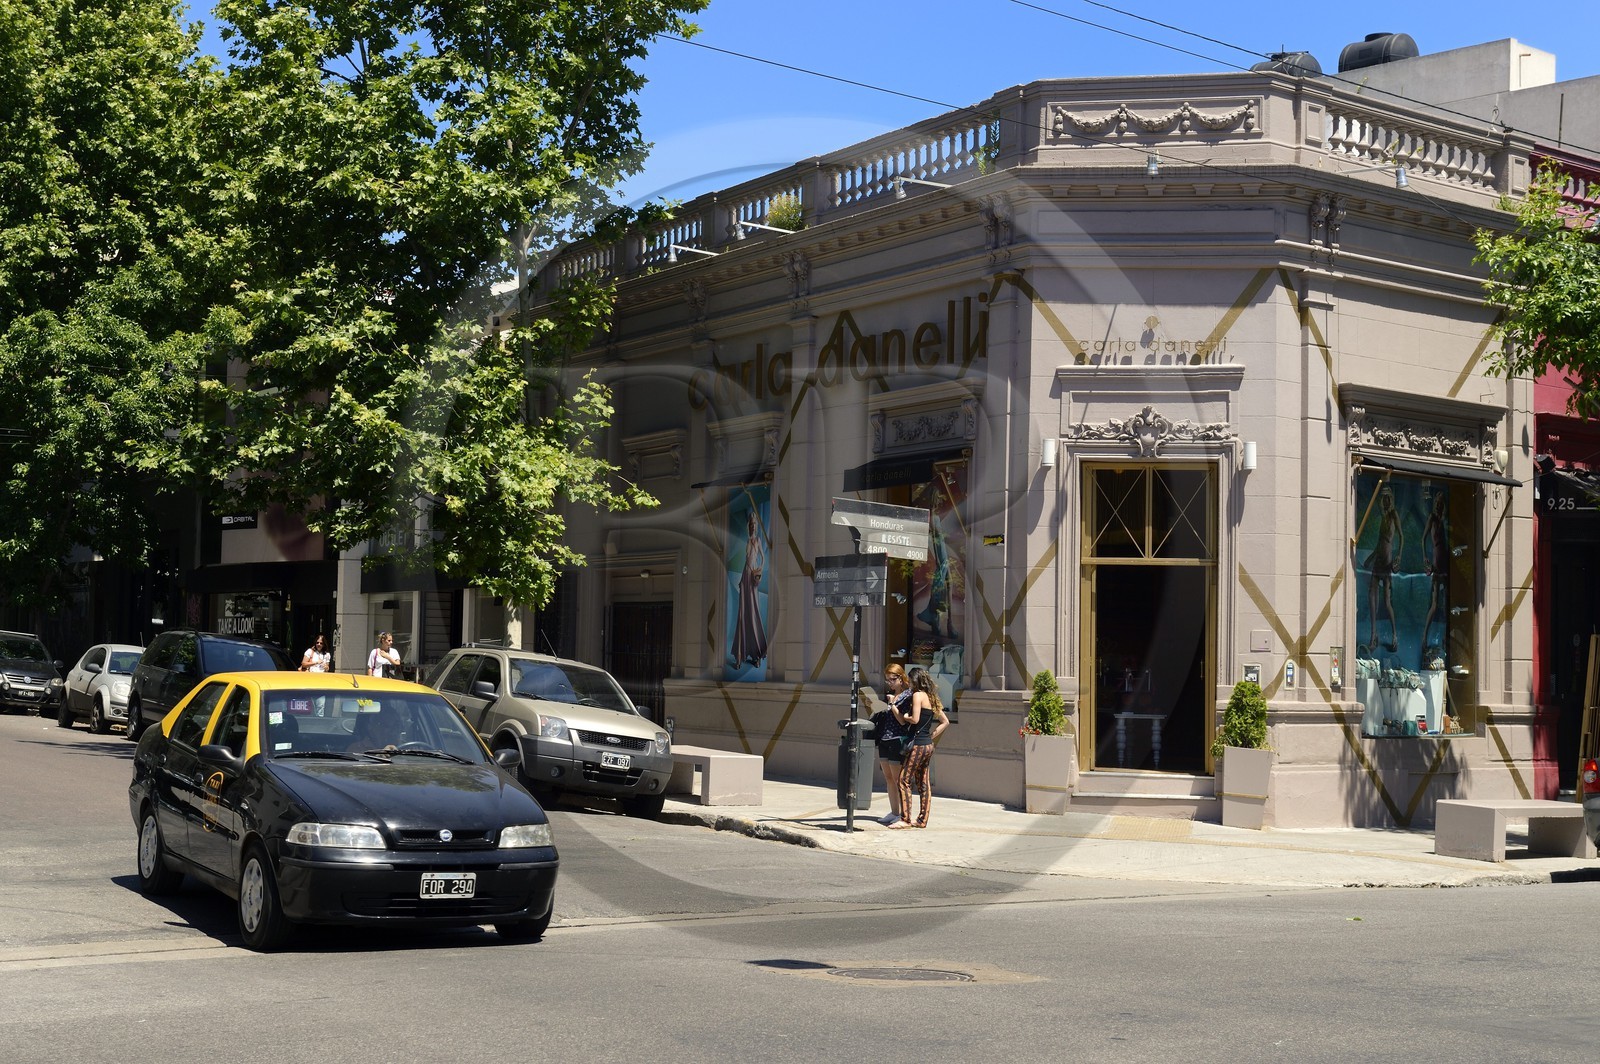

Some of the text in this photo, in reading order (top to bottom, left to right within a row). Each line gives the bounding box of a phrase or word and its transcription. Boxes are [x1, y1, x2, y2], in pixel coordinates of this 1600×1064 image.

[1078, 337, 1228, 353] carla danelli
[687, 292, 988, 411] carla danelli
[1547, 497, 1575, 510] 9.25
[870, 518, 904, 531] Honduras
[906, 550, 924, 560] 4900
[816, 570, 839, 579] Armenia
[815, 596, 827, 605] 1500
[218, 617, 255, 634] TAKE A LOOK!
[290, 700, 309, 711] LIBRE
[617, 758, 630, 767] 097
[210, 778, 220, 789] TAXI
[422, 880, 473, 894] FOR 294
